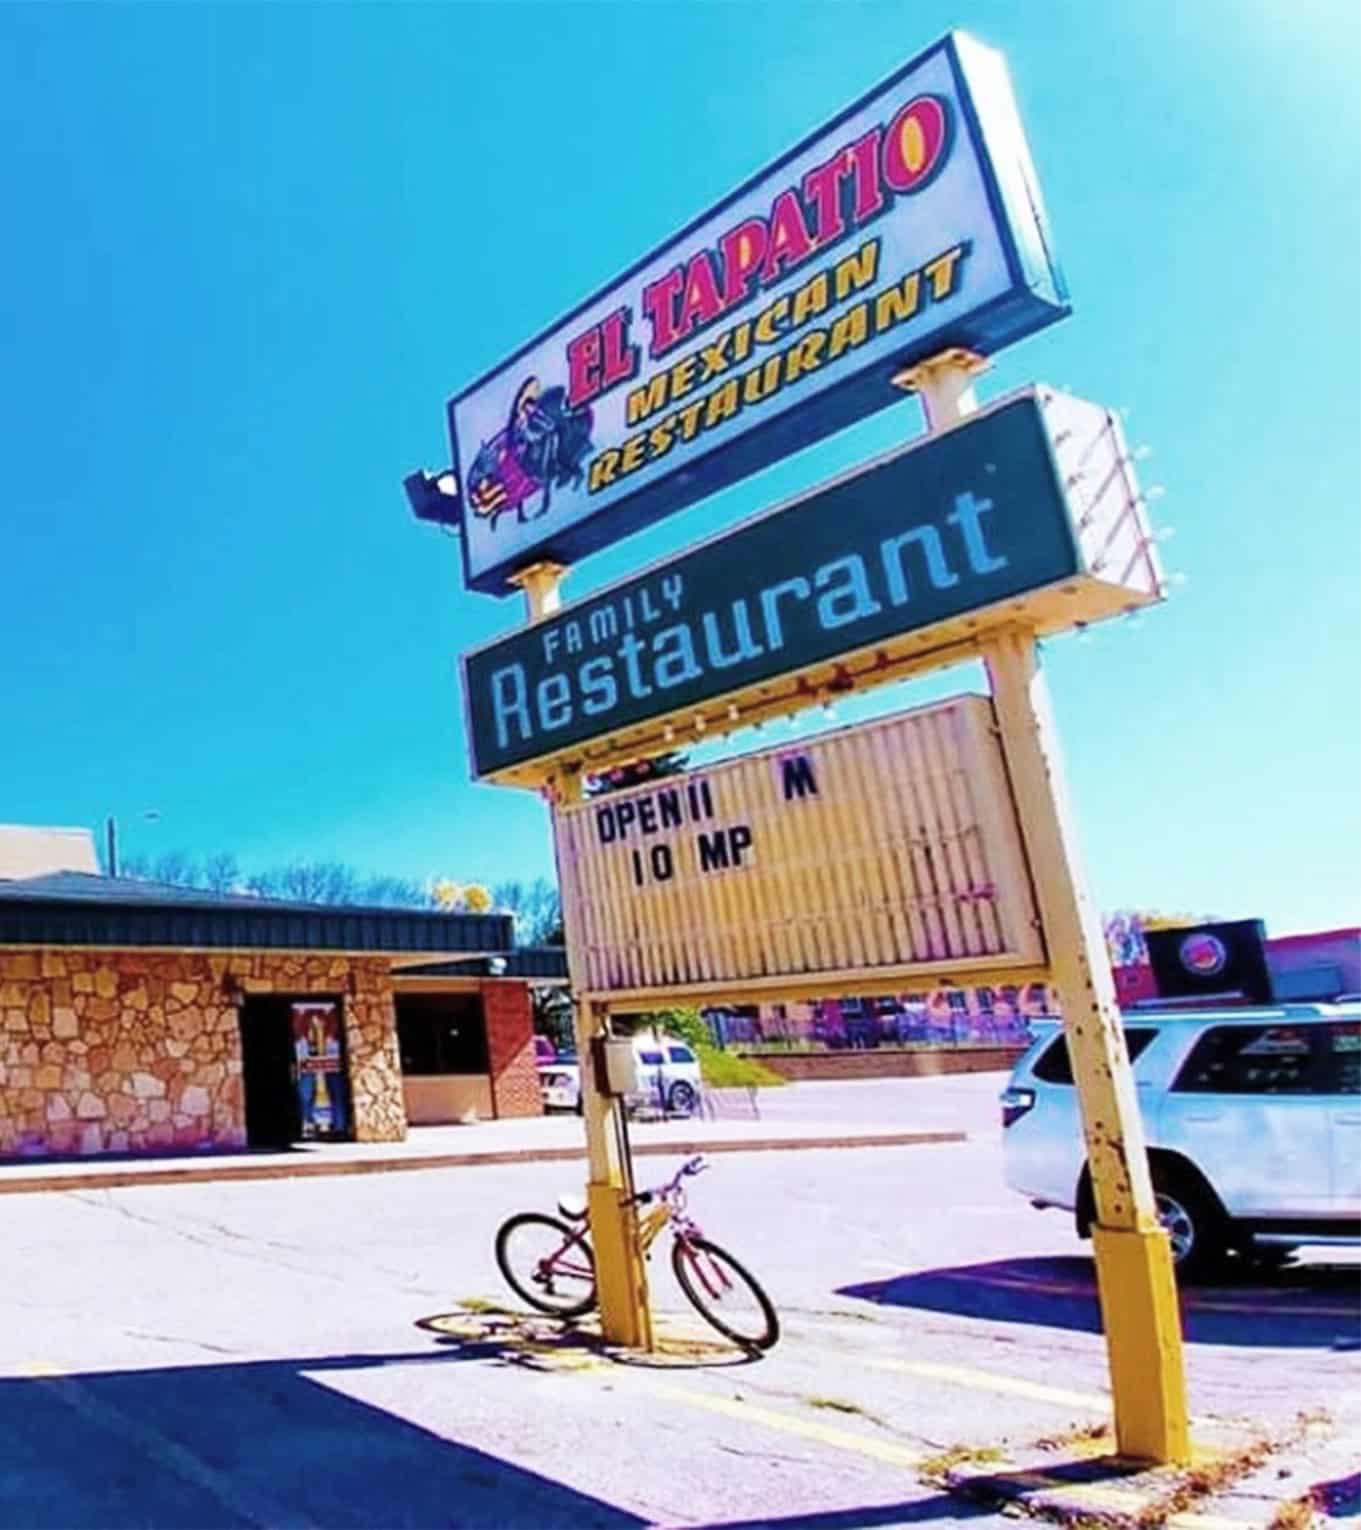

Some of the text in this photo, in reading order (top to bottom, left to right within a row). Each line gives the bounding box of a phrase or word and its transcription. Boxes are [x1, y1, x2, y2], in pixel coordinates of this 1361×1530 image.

[565, 94, 952, 408] EL TAPATIO
[625, 239, 882, 427] MEXICAN
[587, 243, 970, 495] RESTAURANT
[490, 490, 1008, 749] Restaurant
[542, 573, 684, 664] FAMILY
[597, 789, 682, 844] OPEN
[698, 825, 752, 873] MP
